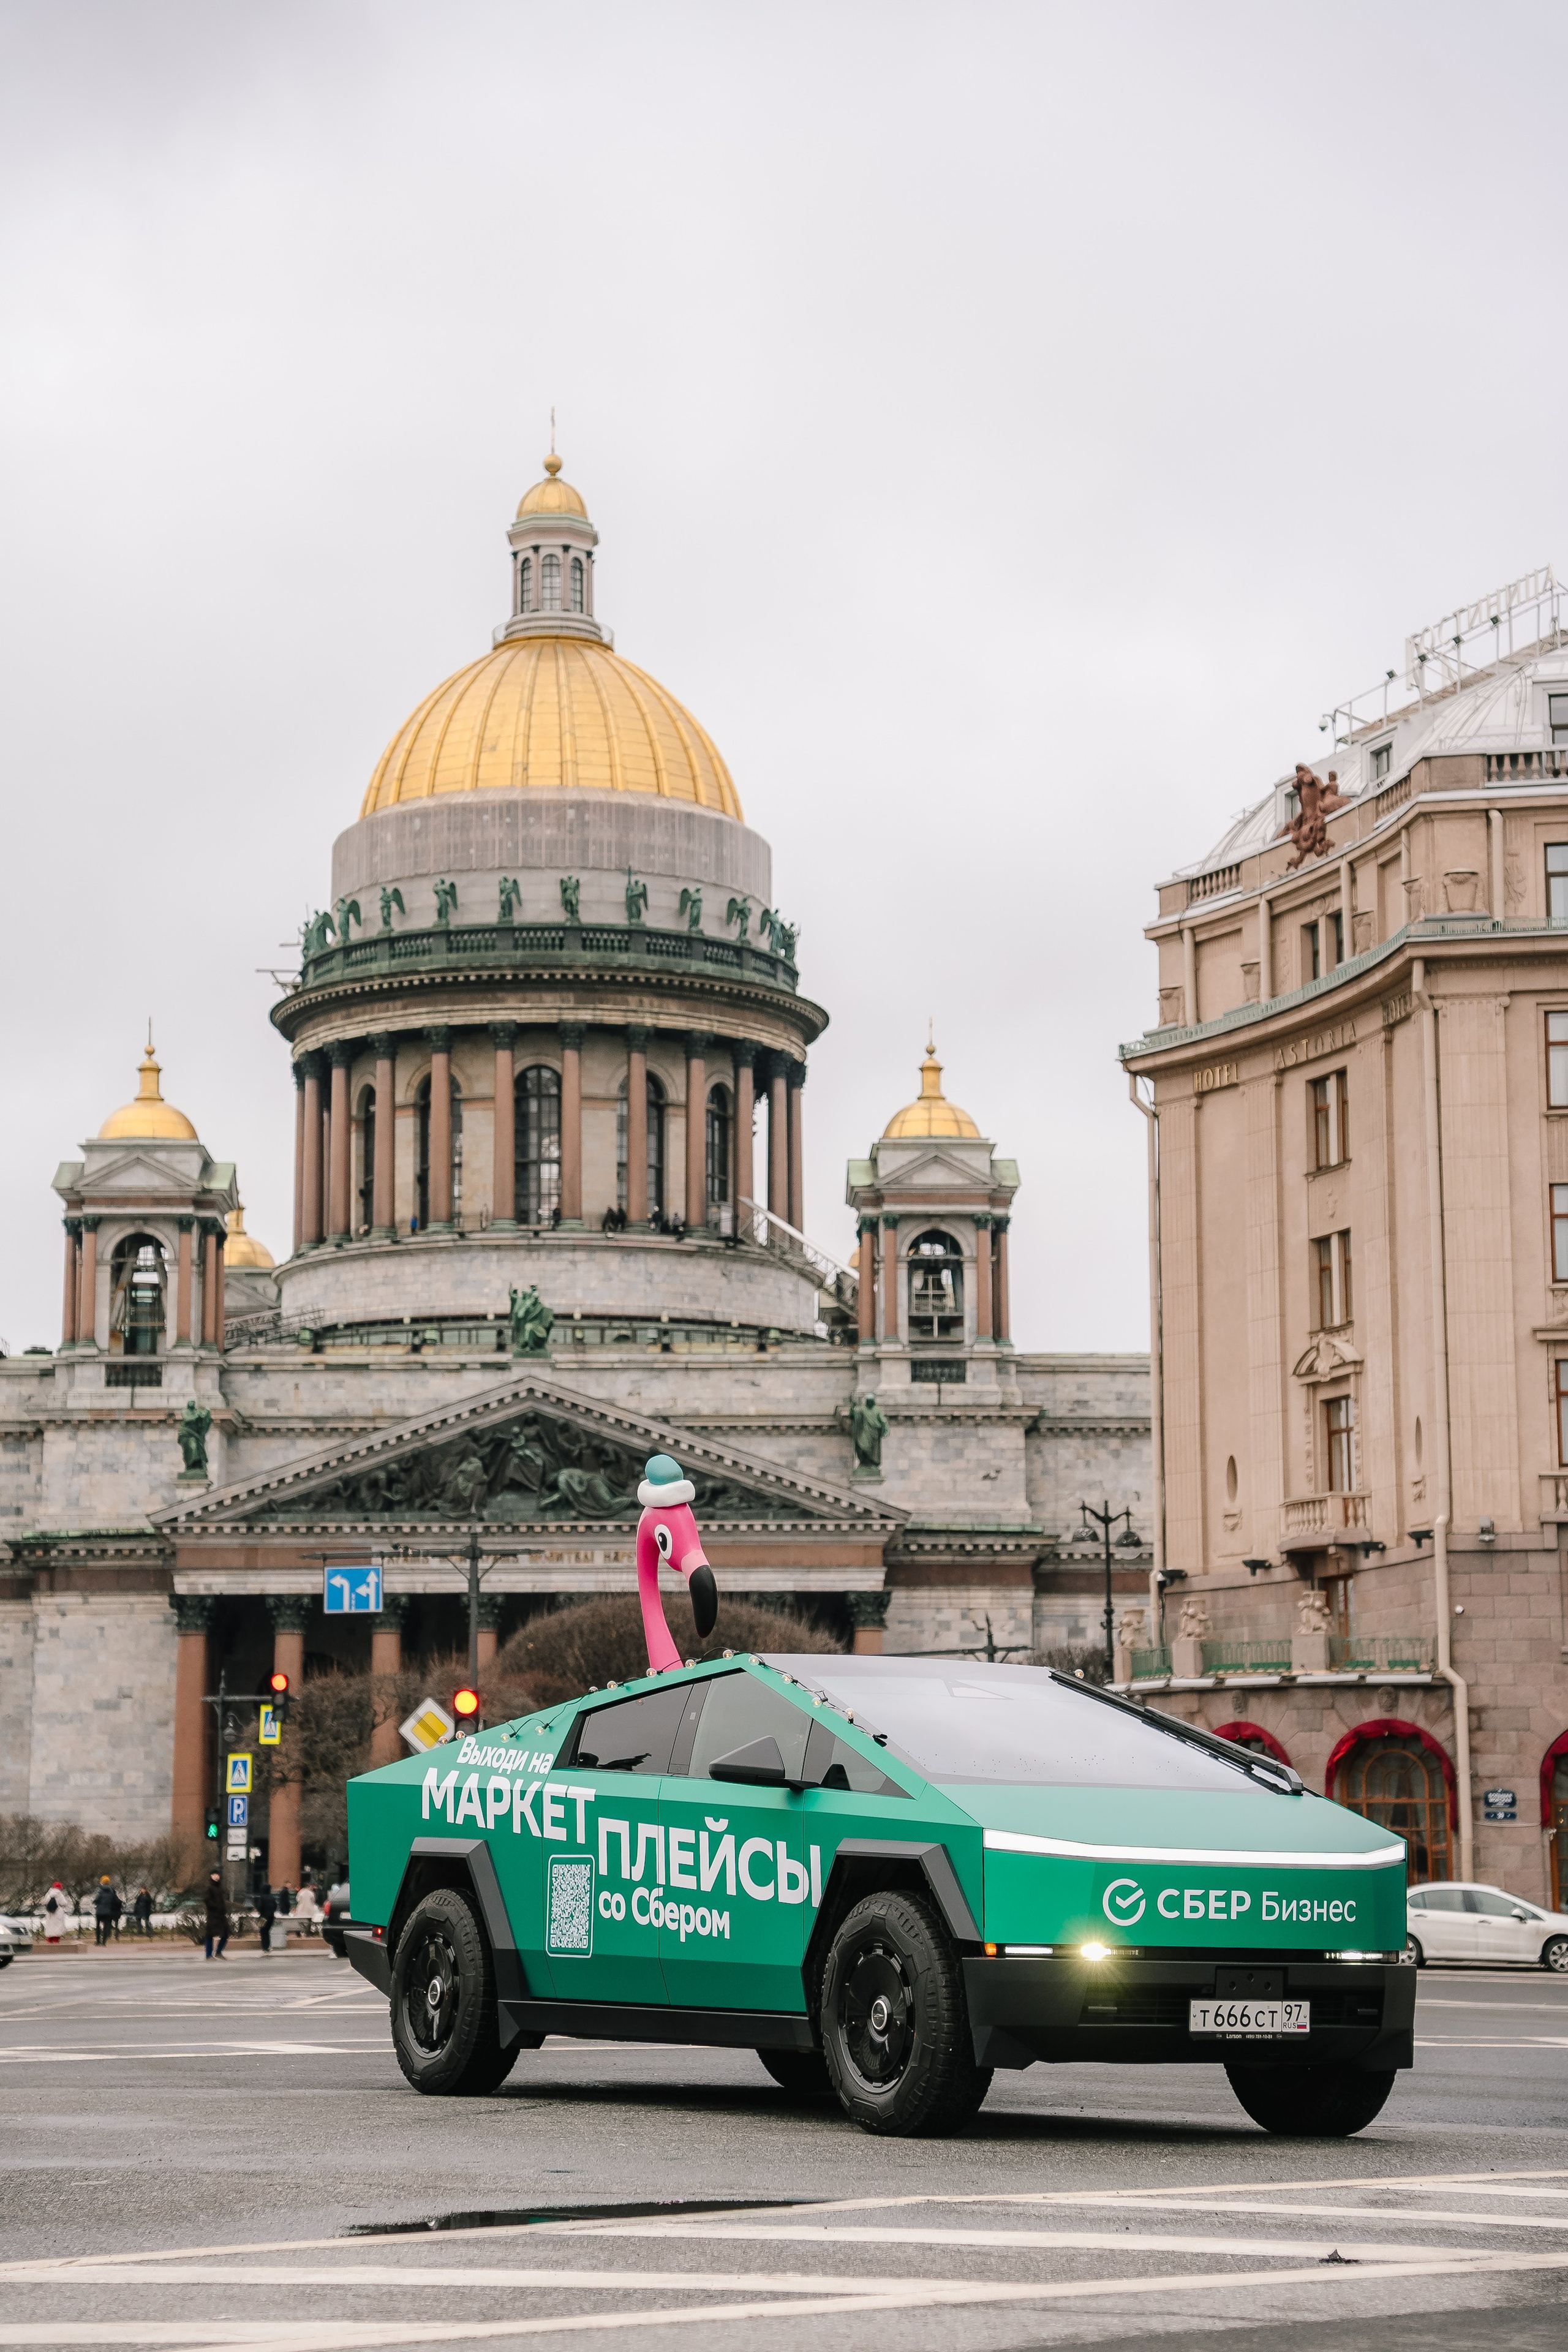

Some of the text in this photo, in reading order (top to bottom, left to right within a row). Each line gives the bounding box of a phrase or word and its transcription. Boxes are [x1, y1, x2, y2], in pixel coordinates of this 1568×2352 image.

[1276, 1021, 1356, 1069] ASTORIA
[456, 1737, 554, 1775] Выходи на
[421, 1767, 597, 1844] МАРКЕТ
[598, 1816, 823, 1908] ПЛЕЙСЫ
[598, 1887, 730, 1943] со Сбером
[1157, 1888, 1357, 1923] СБЕР Бизнес
[1284, 2004, 1303, 2021] 97
